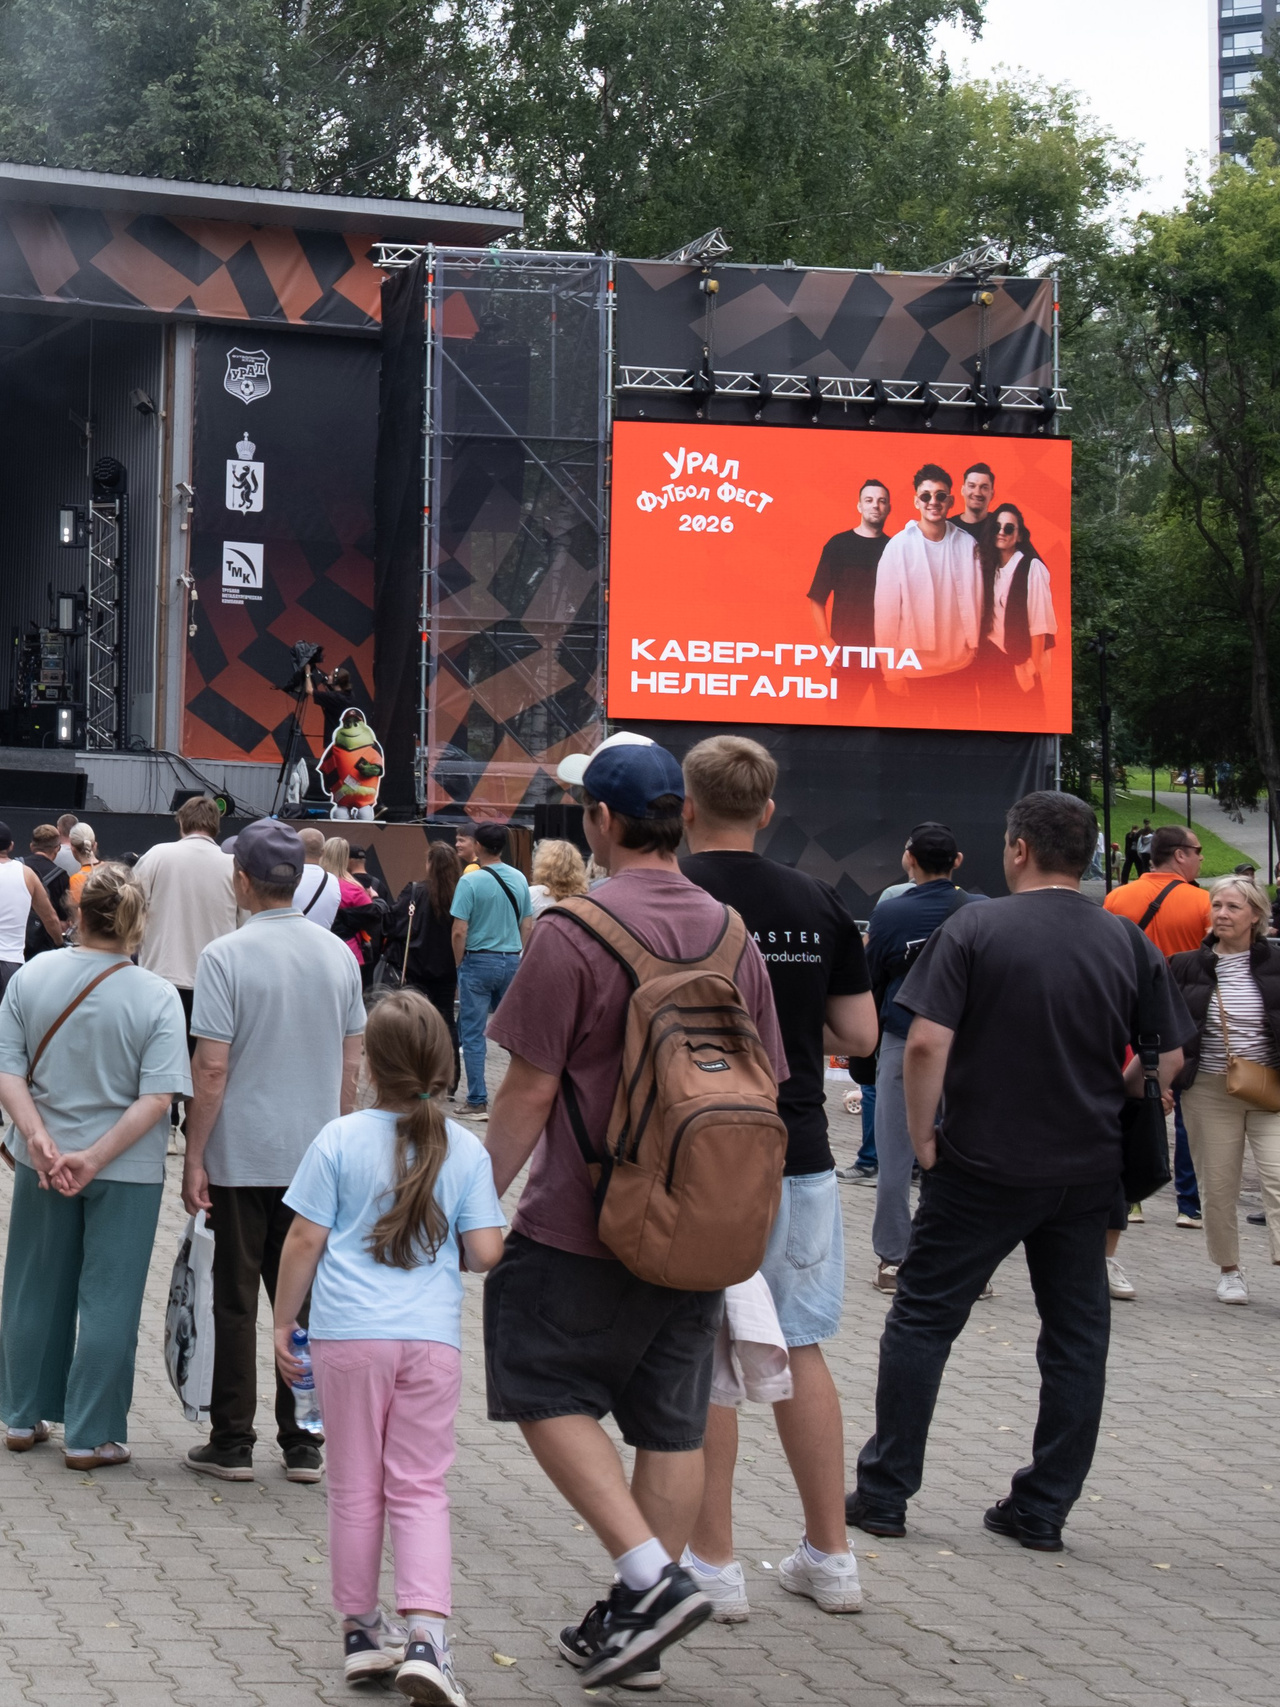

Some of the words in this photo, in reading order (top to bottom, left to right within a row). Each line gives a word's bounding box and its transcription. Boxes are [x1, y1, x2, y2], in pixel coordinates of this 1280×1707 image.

[230, 362, 266, 381] УРАЛ
[662, 446, 740, 480] УРАЛ
[636, 483, 711, 513] ФУТБОЛ
[716, 481, 774, 514] ФЕСТ
[678, 514, 734, 533] 2026
[225, 560, 251, 584] ТМК
[630, 638, 923, 671] КАВЕР-ГРУППА
[630, 671, 838, 700] НЕЛЕГАЛЫ
[753, 931, 820, 945] ASTER
